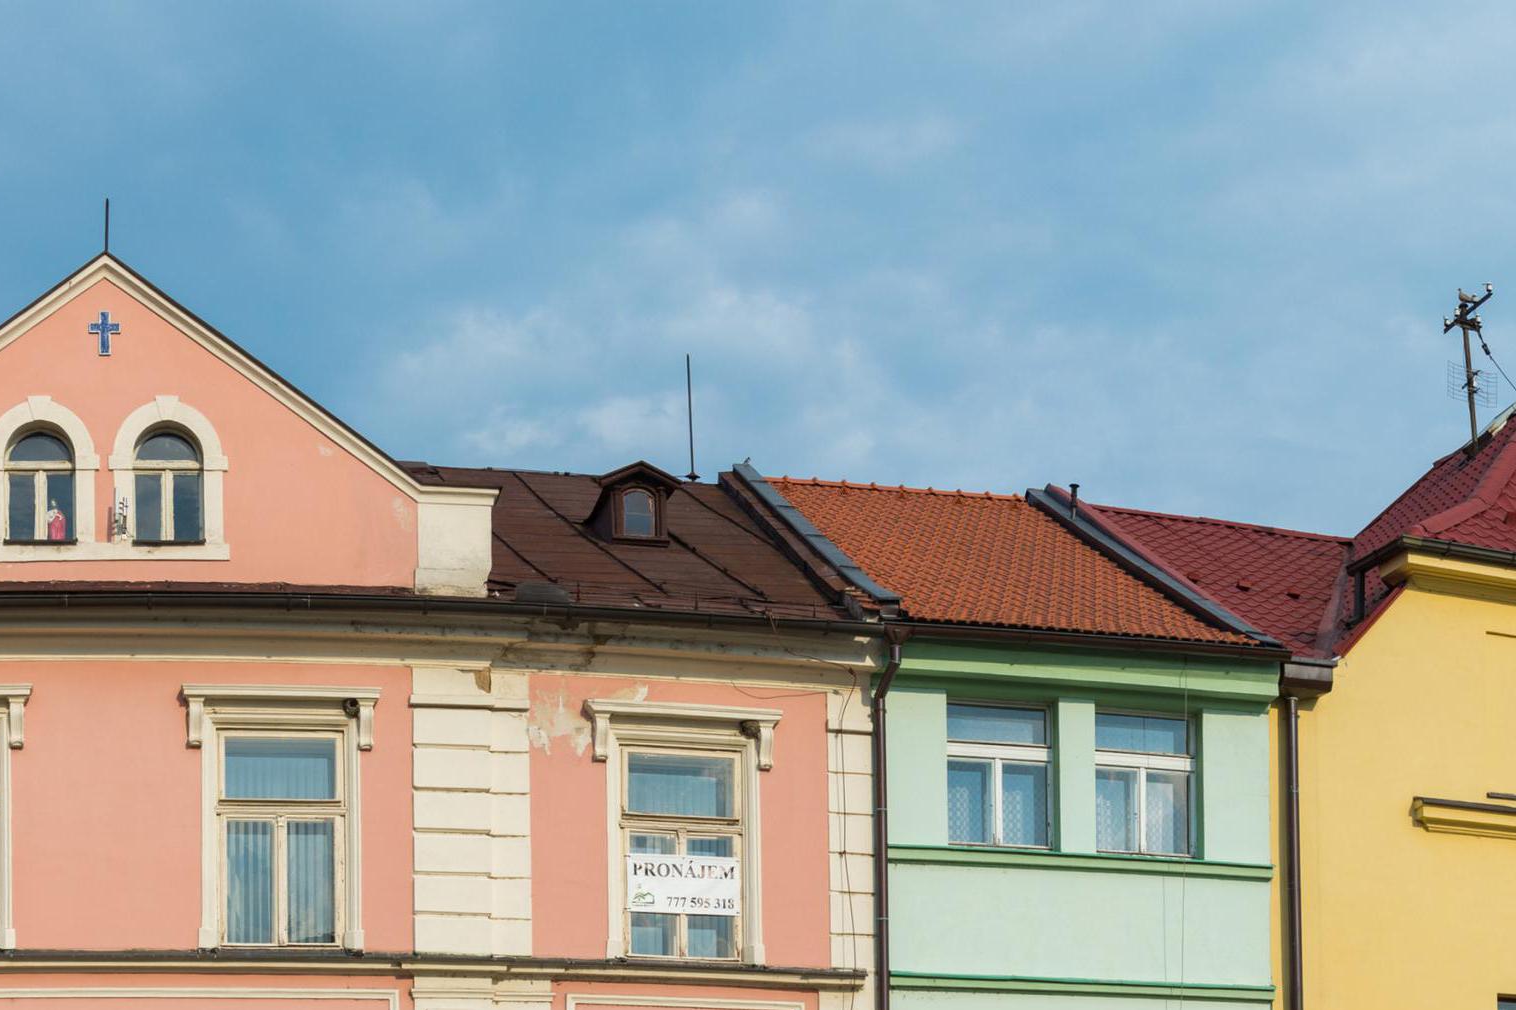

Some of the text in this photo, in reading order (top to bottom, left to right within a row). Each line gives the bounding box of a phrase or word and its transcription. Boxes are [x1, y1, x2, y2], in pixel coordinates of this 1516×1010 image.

[633, 860, 735, 879] PRONÁJEM
[666, 896, 686, 908] 777
[690, 897, 711, 909] 595
